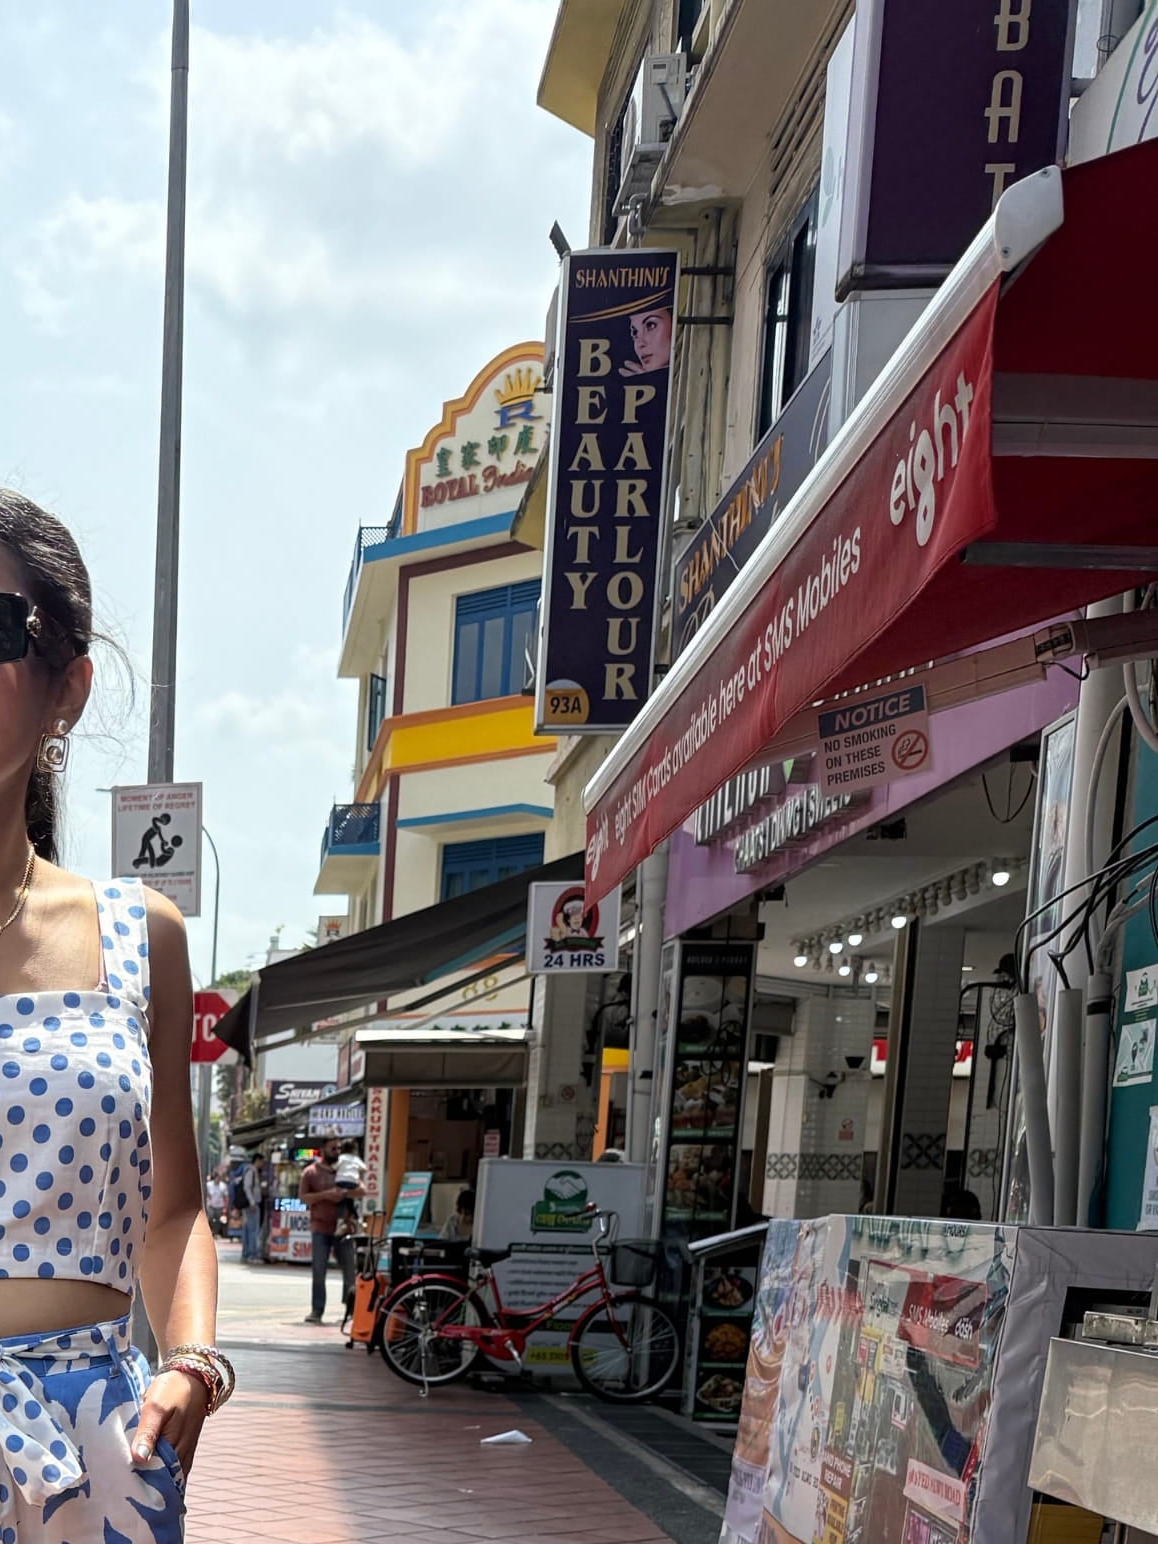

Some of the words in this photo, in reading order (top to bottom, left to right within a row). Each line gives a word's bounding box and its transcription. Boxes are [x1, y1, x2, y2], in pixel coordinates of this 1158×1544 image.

[575, 266, 670, 289] SHANTHINI'S
[436, 425, 551, 478] 皇家印度
[889, 370, 974, 547] eight
[420, 473, 479, 508] ROYAL
[564, 338, 612, 610] BEAUTY
[602, 384, 656, 700] PARLOUR
[672, 693, 718, 773] available
[718, 665, 746, 725] here
[747, 641, 762, 689] at
[764, 598, 794, 672] SMS
[795, 526, 861, 638] Mobiles
[550, 696, 582, 714] 93A
[833, 693, 912, 731] NOTICE
[824, 739, 841, 754] NO
[844, 724, 896, 749] SMOKING
[826, 756, 842, 770] ON
[845, 745, 882, 764] THESE
[827, 762, 886, 786] PREMISES
[543, 954, 565, 969] 24
[569, 953, 606, 968] HRS
